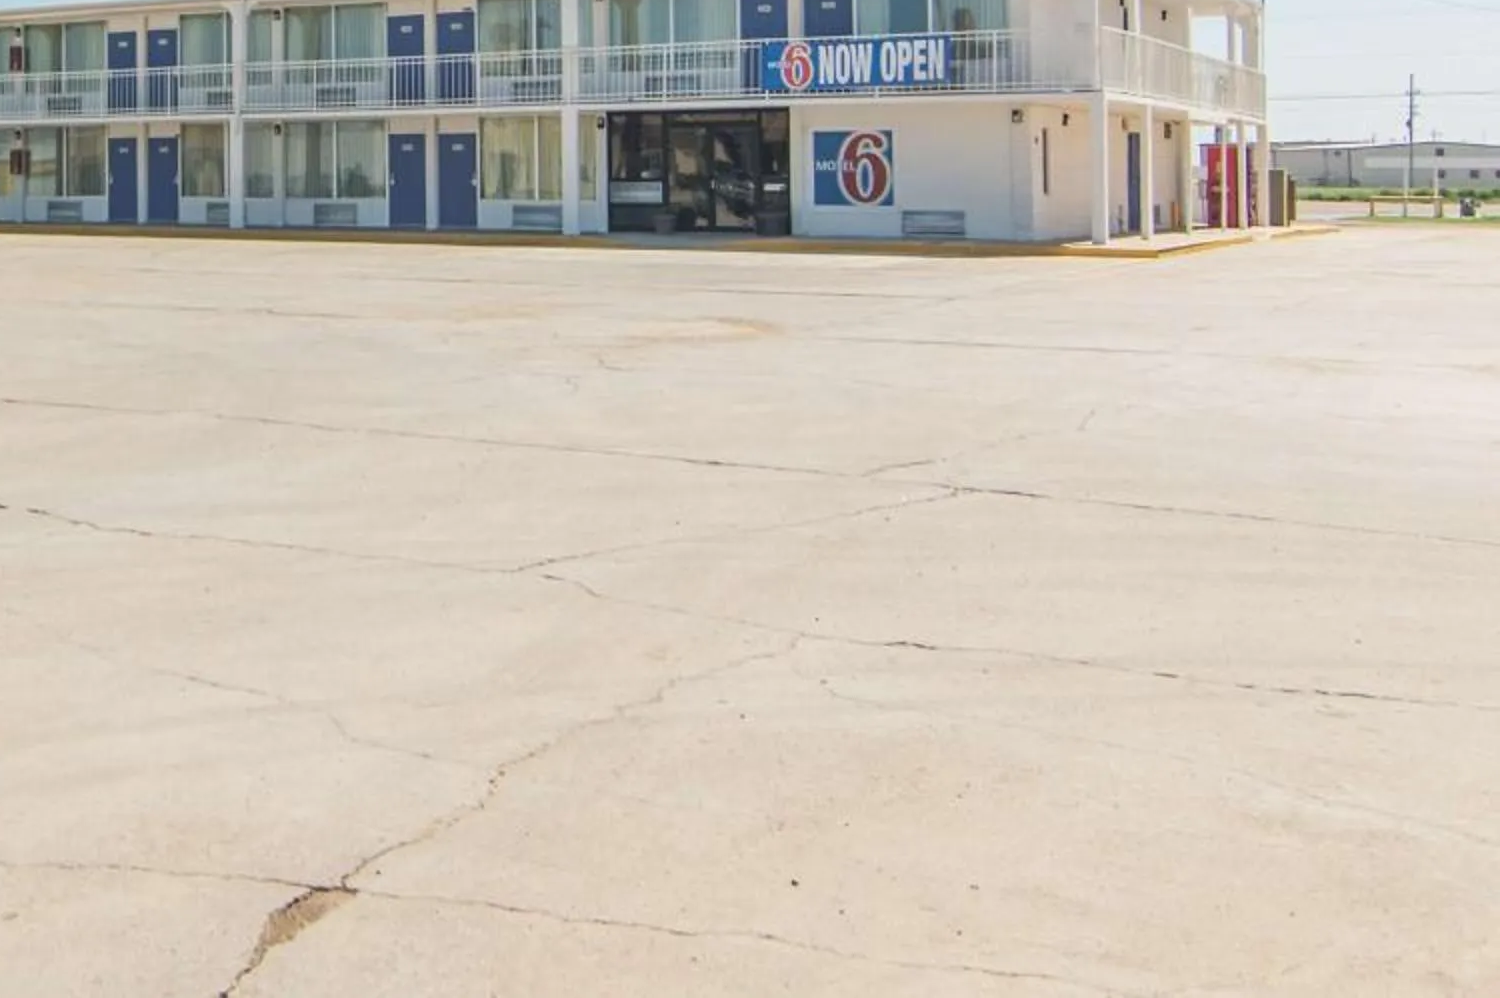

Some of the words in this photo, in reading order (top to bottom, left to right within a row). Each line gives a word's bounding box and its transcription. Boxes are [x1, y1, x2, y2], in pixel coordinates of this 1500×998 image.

[783, 43, 812, 89] 6
[818, 42, 873, 85] NOW
[880, 39, 945, 83] OPEN
[841, 132, 888, 204] 6
